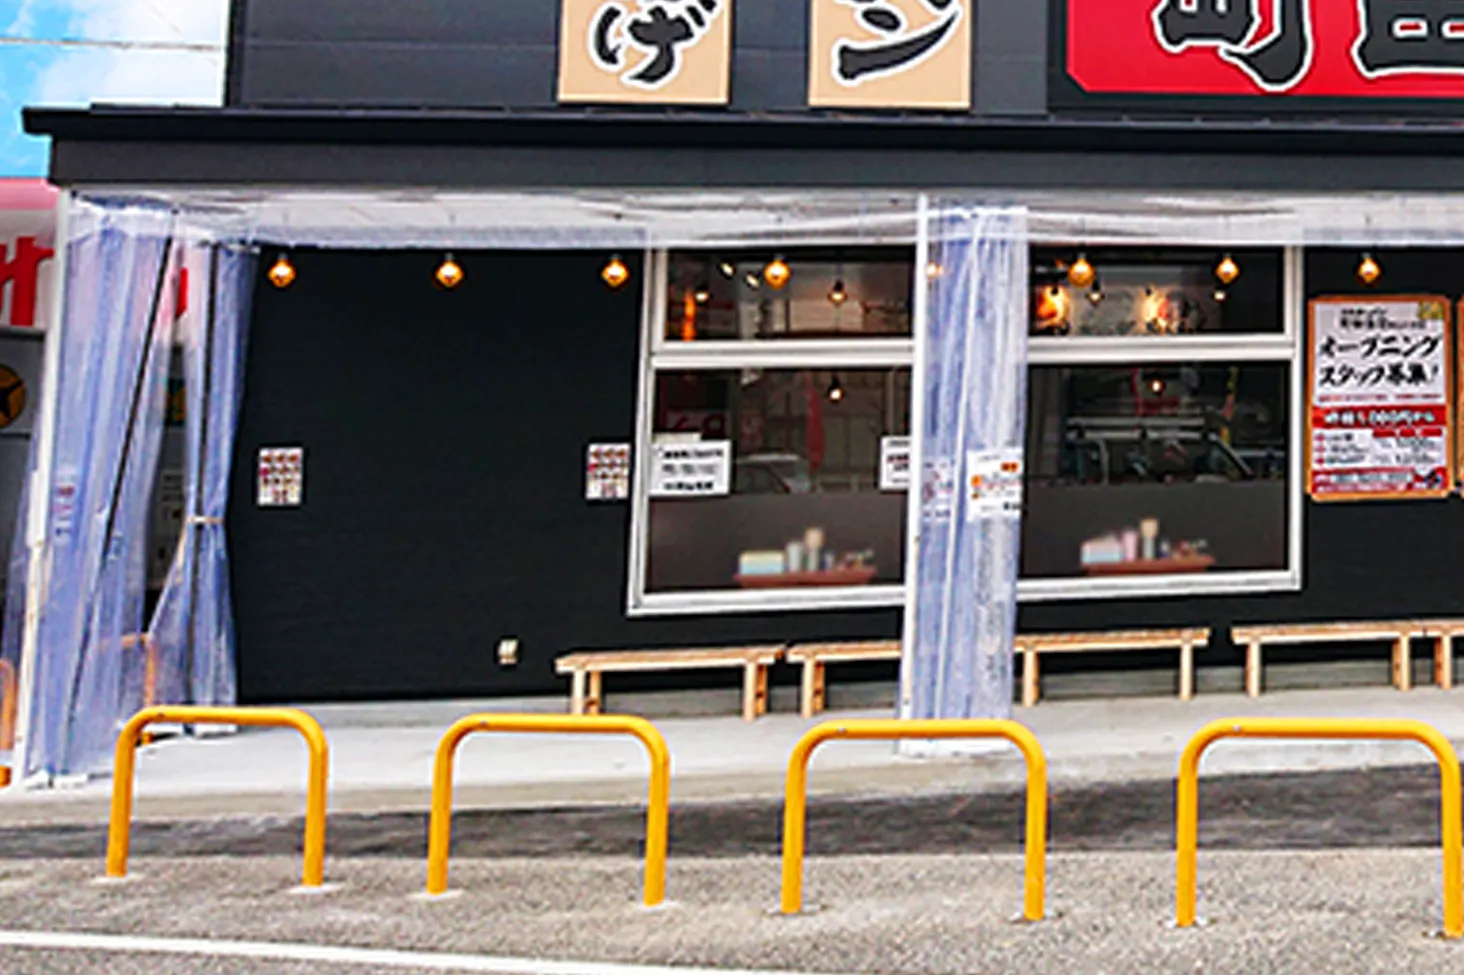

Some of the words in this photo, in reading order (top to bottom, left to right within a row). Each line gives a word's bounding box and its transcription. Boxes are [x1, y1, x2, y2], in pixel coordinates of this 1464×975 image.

[1318, 333, 1443, 360] オープニング
